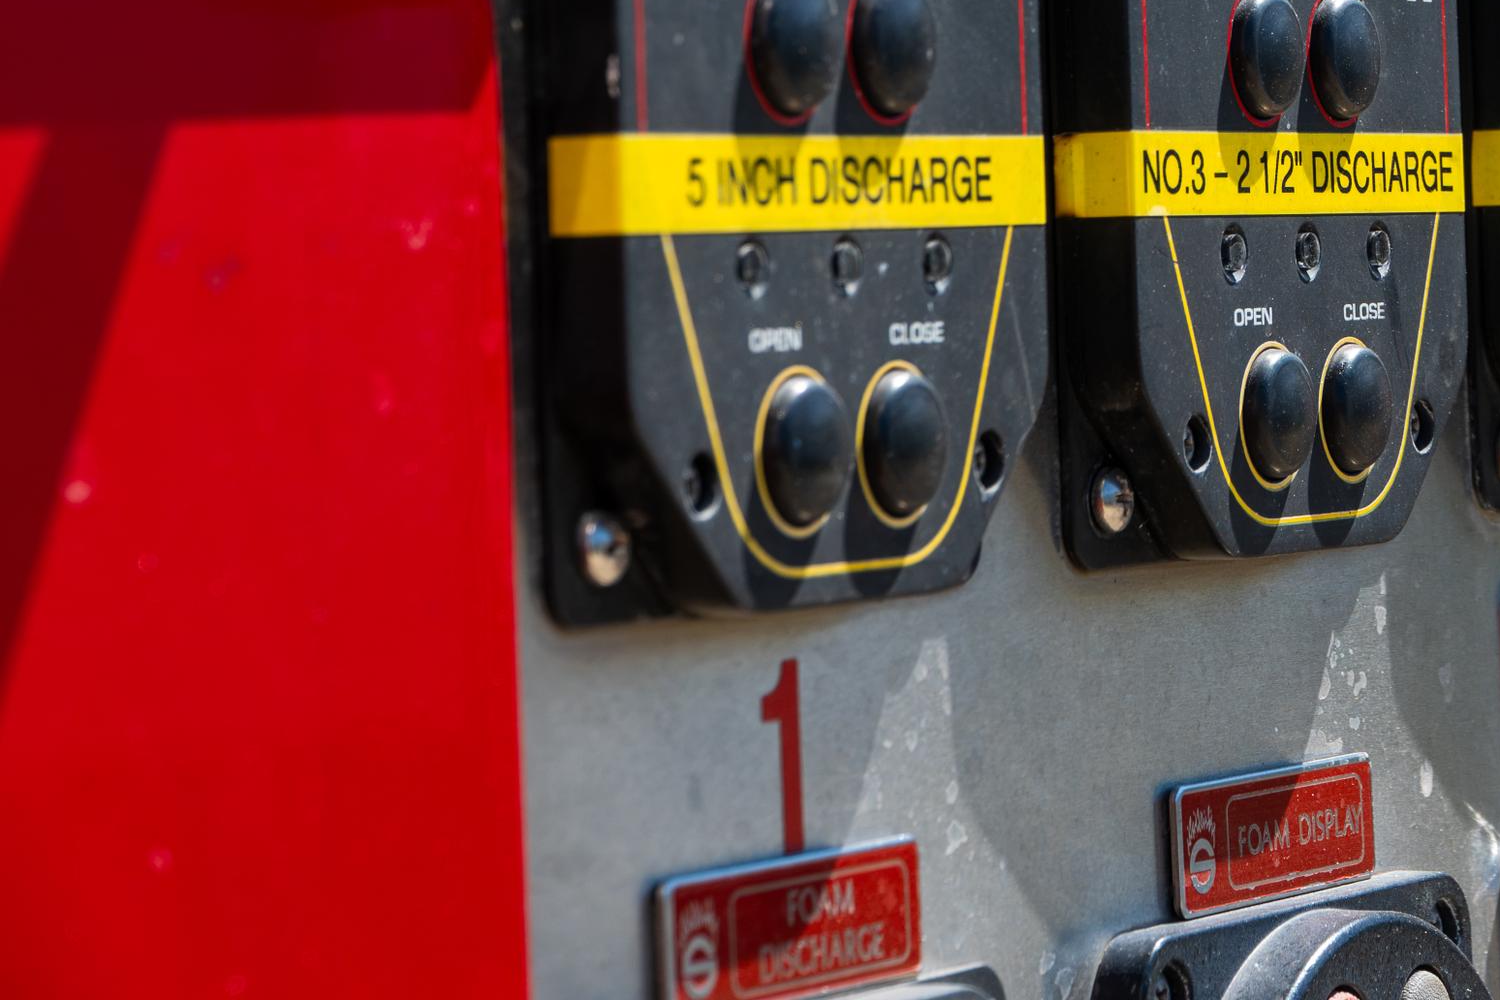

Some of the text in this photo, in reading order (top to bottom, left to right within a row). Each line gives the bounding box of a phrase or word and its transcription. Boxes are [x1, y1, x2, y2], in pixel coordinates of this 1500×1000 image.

[686, 156, 993, 207] 5 INCH DISCHARGE
[1143, 149, 1205, 194] NO.3
[1313, 151, 1453, 193] DISCHARGE
[748, 321, 944, 353] OPEN CLOSE
[1234, 302, 1385, 326] OPEN CLOSE
[761, 657, 805, 856] 1
[1238, 803, 1364, 857] FOAM DISPLAY
[786, 878, 856, 927] FOAM
[758, 922, 885, 983] DISCHARGE
